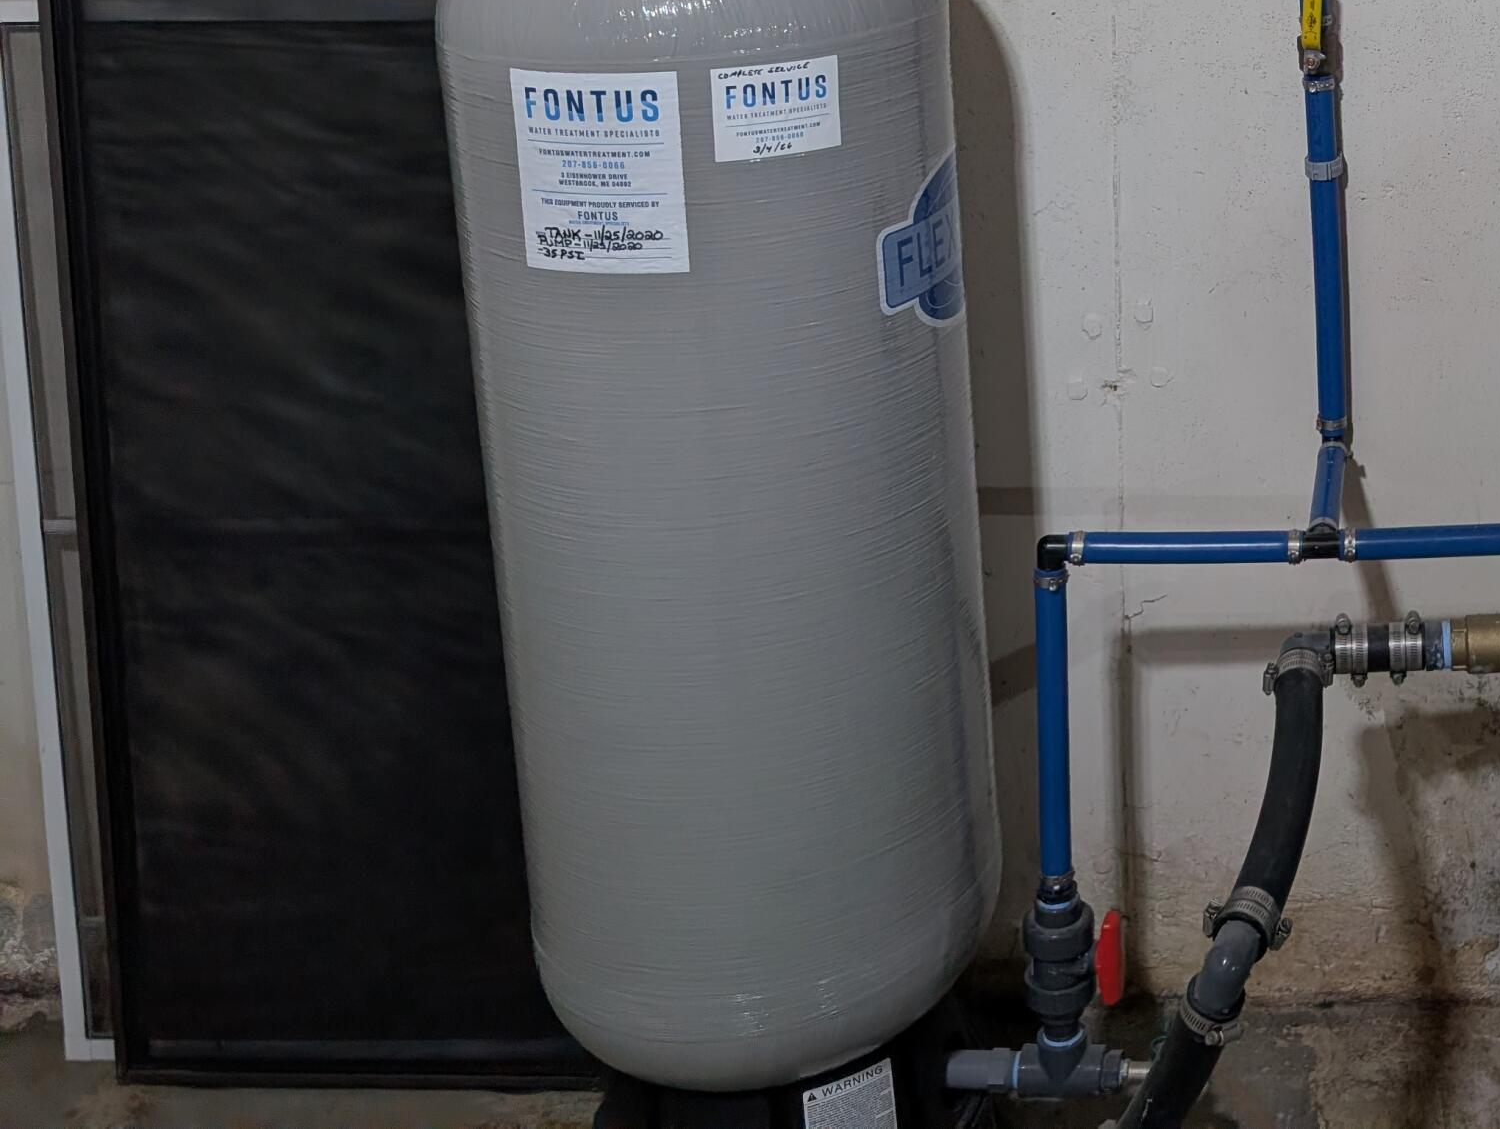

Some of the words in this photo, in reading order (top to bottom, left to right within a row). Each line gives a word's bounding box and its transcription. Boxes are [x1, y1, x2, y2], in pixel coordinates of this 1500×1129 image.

[725, 74, 827, 110] FONTUS
[525, 86, 660, 122] FONTUS
[727, 112, 748, 121] WATER
[750, 109, 787, 119] TREATMENT
[788, 103, 827, 114] SPECIALISTS
[528, 126, 552, 135] WATER
[554, 127, 600, 137] TREATMENT
[604, 129, 660, 138] SPECIALISTS
[566, 172, 607, 180] EISENHOWER
[541, 197, 553, 205] THIS
[554, 199, 587, 208] EQUIPMENT
[588, 200, 617, 209] PROUDLY
[577, 210, 619, 221] FONTUS
[545, 227, 581, 241] TANK
[538, 235, 572, 247] PUMP
[560, 248, 586, 260] PSI
[821, 1065, 883, 1097] WARNING
